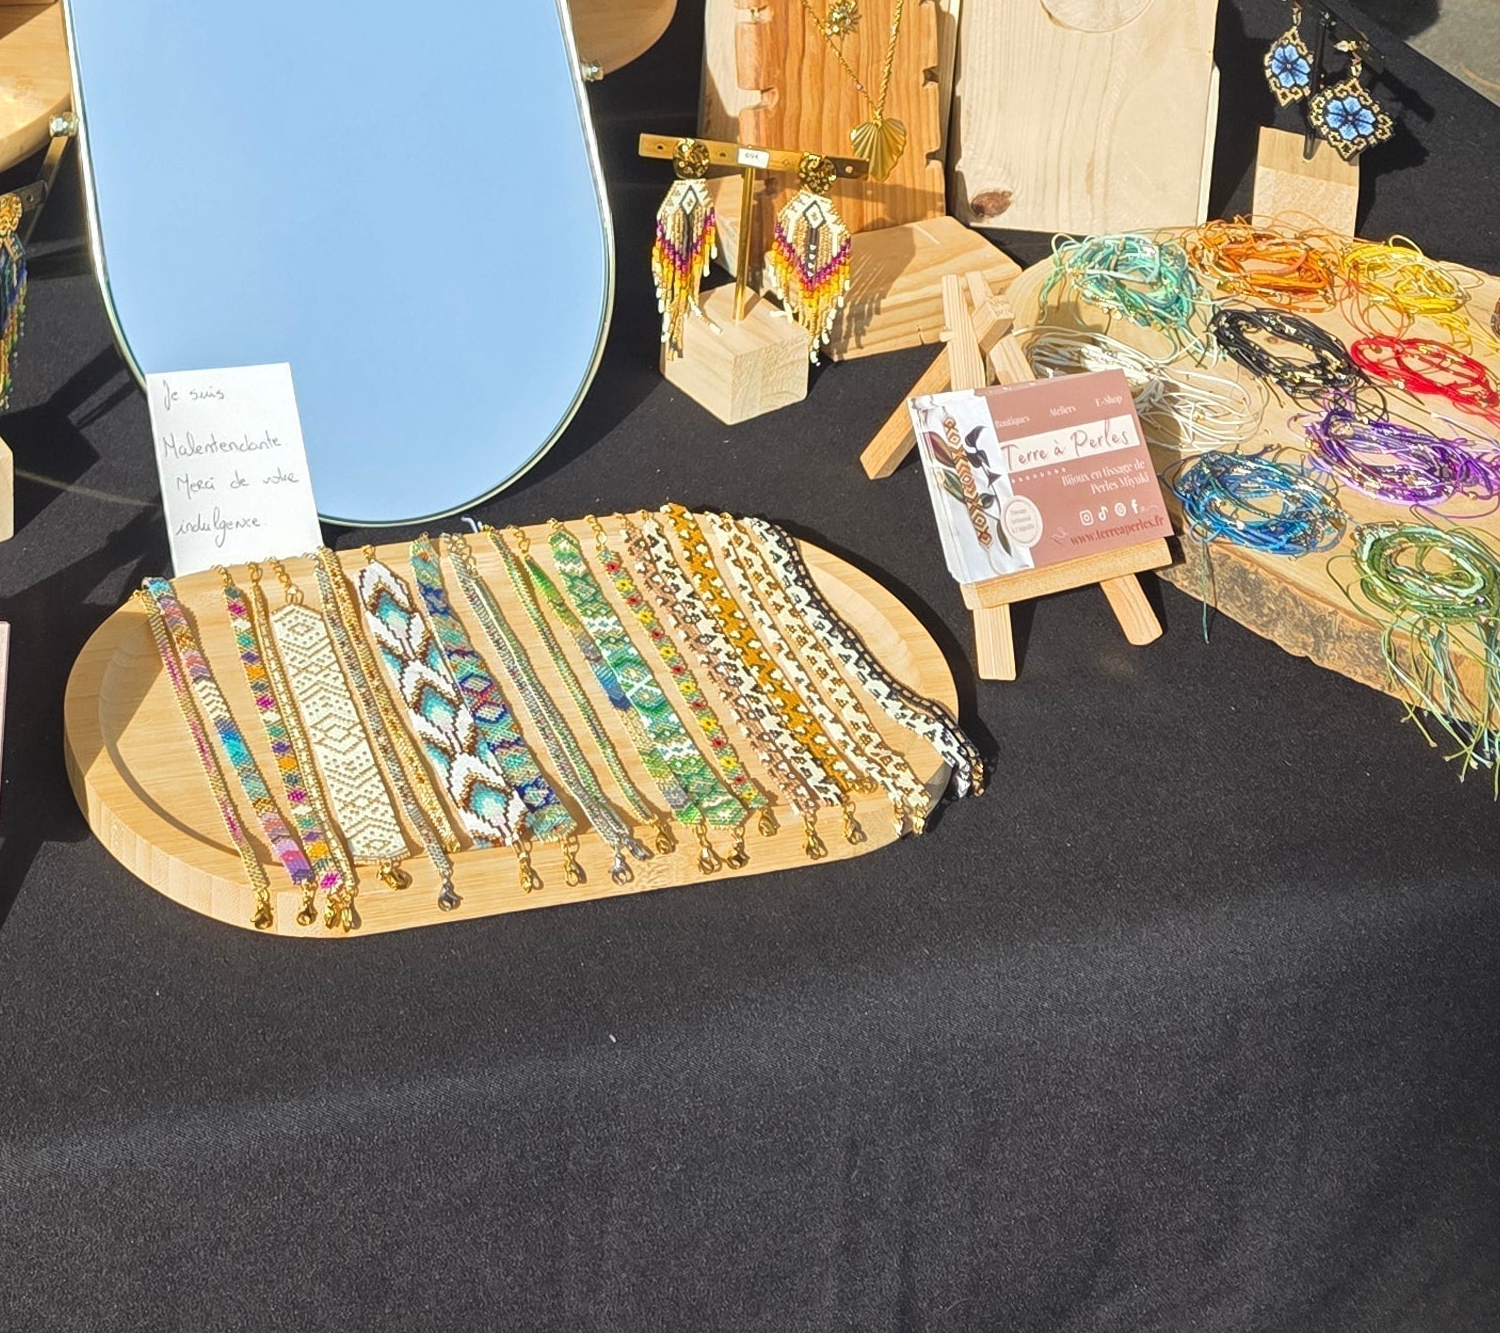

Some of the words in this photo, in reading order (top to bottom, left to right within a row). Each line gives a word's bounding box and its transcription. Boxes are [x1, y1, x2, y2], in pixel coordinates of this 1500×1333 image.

[163, 379, 178, 411] Je
[190, 386, 225, 400] suis
[1050, 405, 1076, 417] Ateliers
[1095, 395, 1123, 408] E-Shop
[1001, 443, 1048, 470] Terre
[1054, 439, 1066, 456] à
[1070, 420, 1129, 458] Perles
[176, 473, 215, 500] Merci
[230, 470, 251, 489] de
[262, 467, 300, 484] votre
[1061, 471, 1089, 486] Bijoux
[1091, 469, 1102, 479] en
[1103, 462, 1133, 478] tissage
[1134, 459, 1145, 470] de
[1091, 480, 1118, 494] Perles
[1120, 473, 1150, 490] Miyuki
[1070, 515, 1164, 546] www.terreaperles.fr
